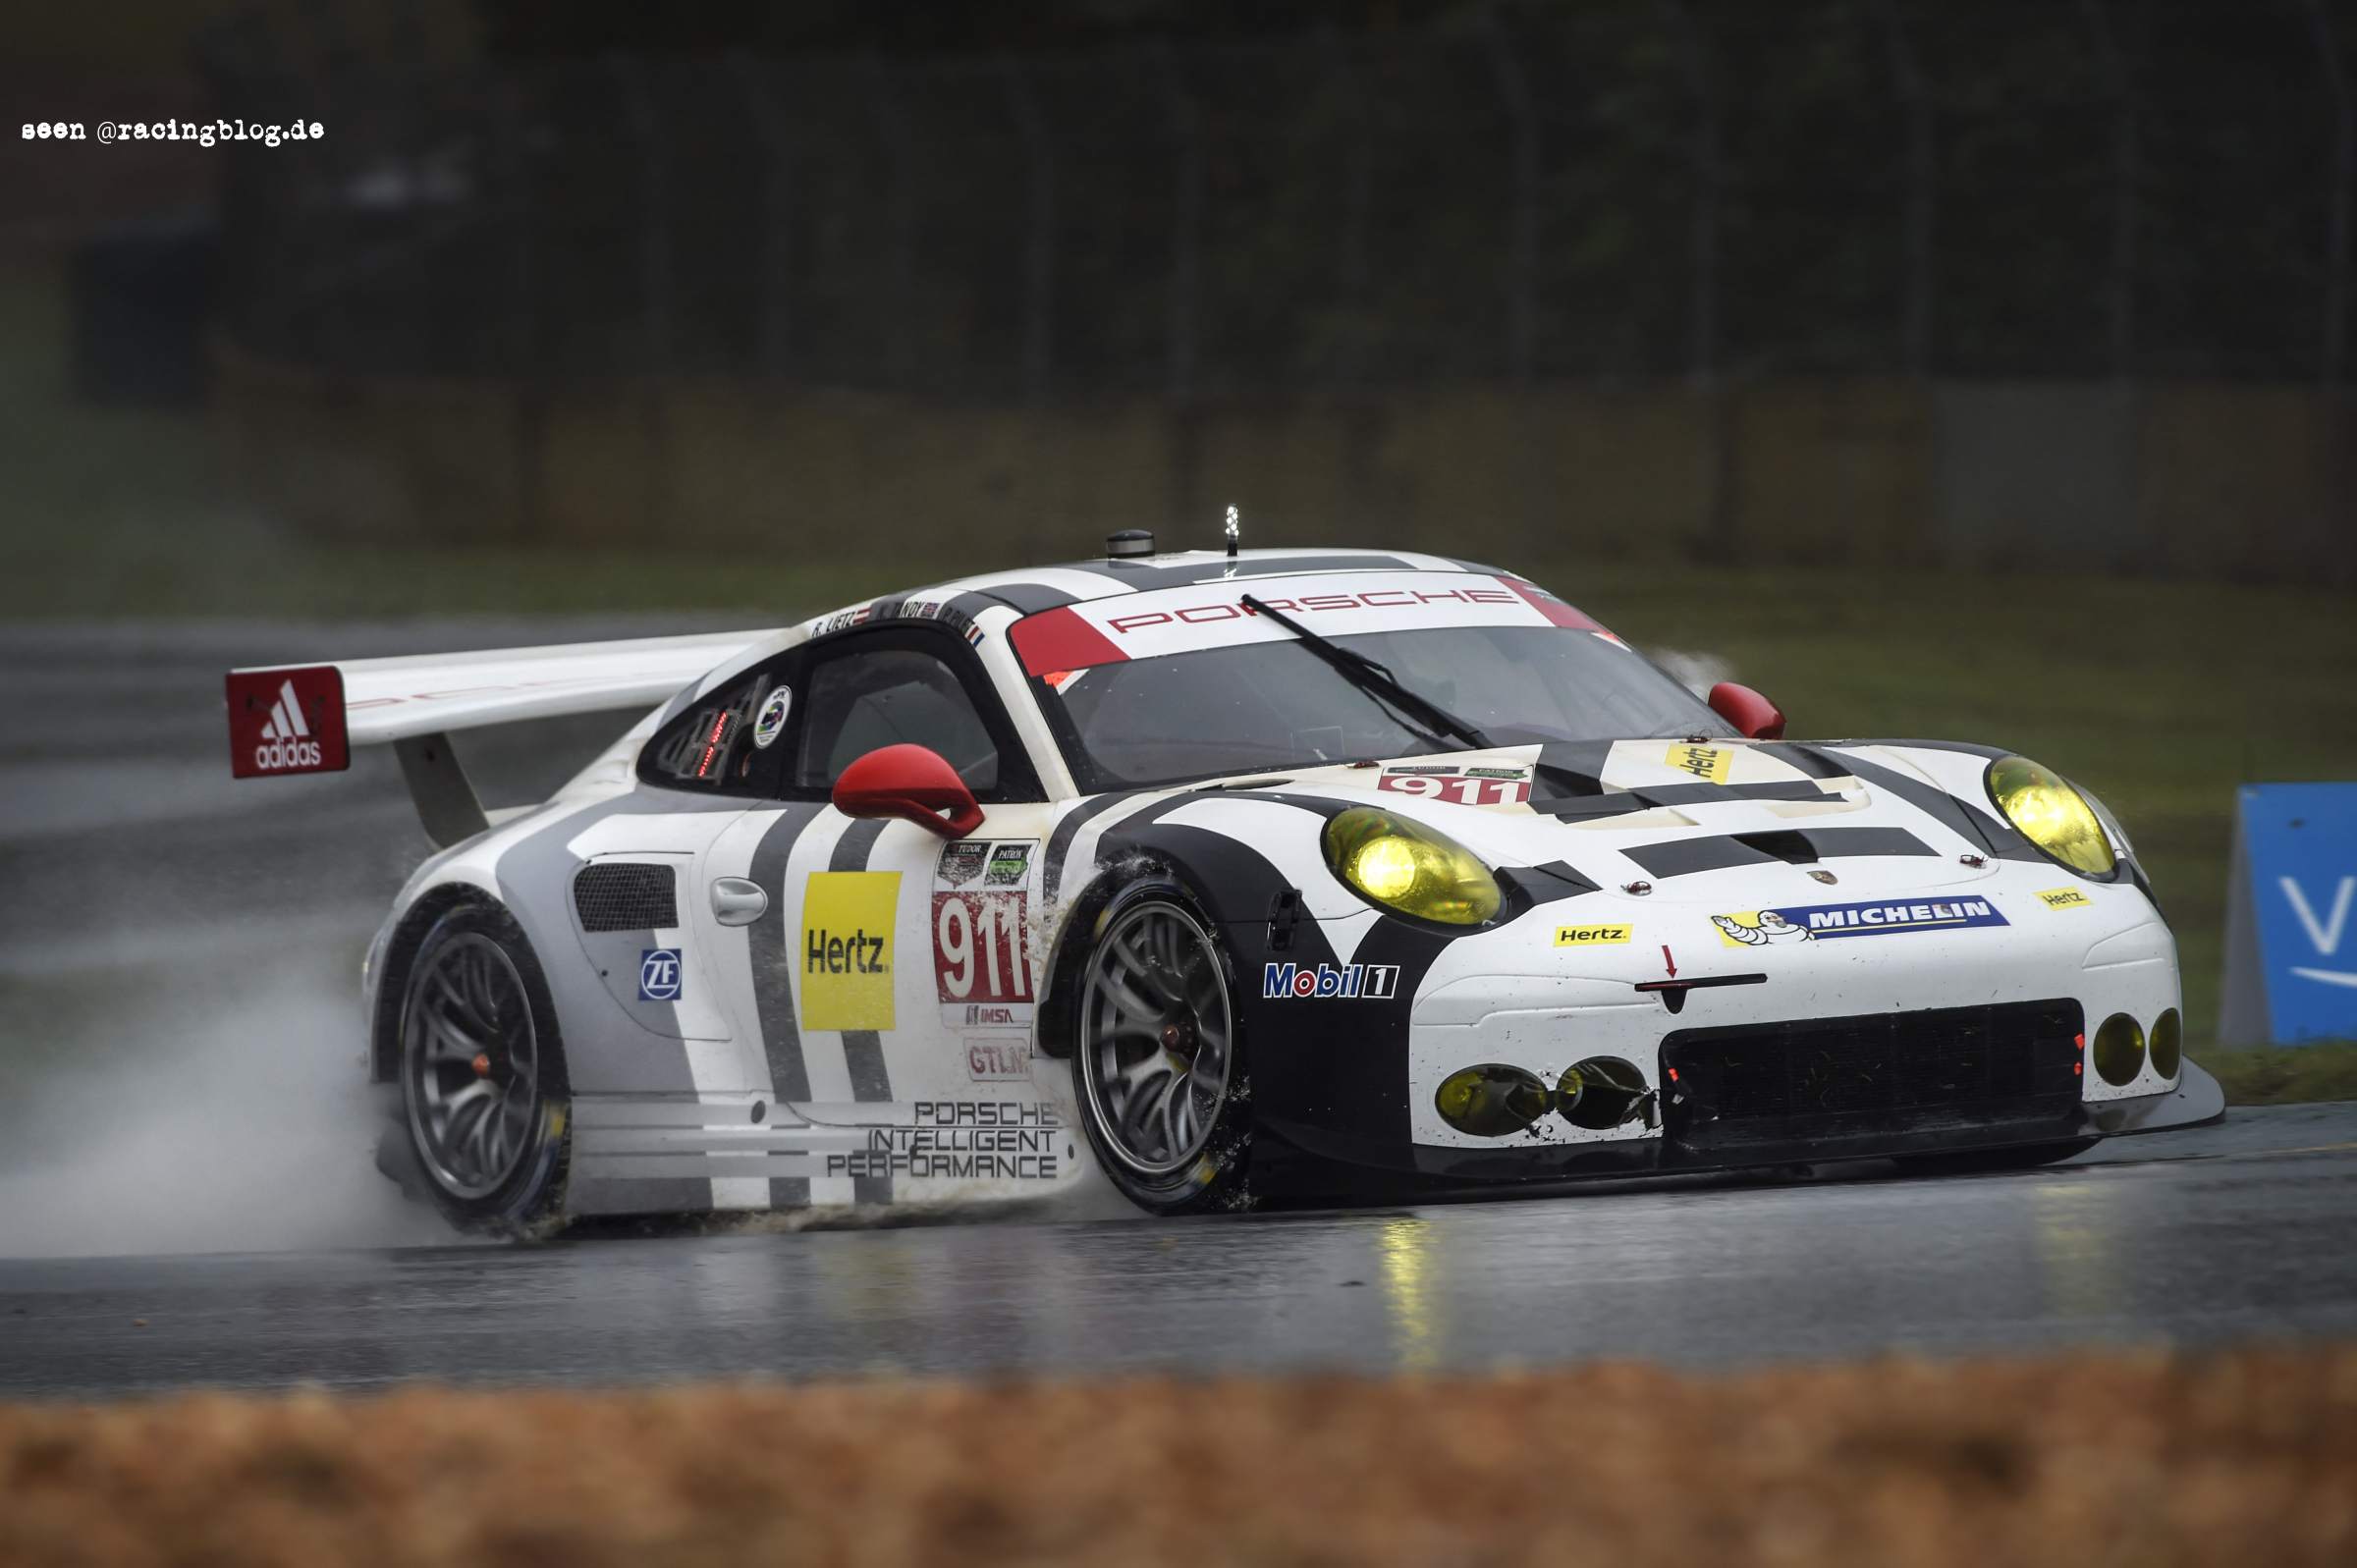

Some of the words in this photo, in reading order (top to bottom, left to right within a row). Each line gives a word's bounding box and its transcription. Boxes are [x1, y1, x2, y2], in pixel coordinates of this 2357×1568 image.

[1107, 589, 1520, 634] PORSCHE
[256, 736, 321, 770] adidas
[1679, 747, 1718, 778] Hertz
[1390, 777, 1520, 805] 911
[2043, 892, 2086, 905] Hertz
[1808, 901, 1992, 928] MICHELIN
[939, 896, 1027, 999] 911
[646, 959, 681, 989] ZF
[1263, 962, 1364, 999] Mobil
[980, 1008, 1014, 1023] IMSA
[914, 1102, 1059, 1125] PORSCHE
[868, 1130, 1058, 1152] INTELLIGENT
[827, 1155, 1058, 1178] PERFORMANCE
